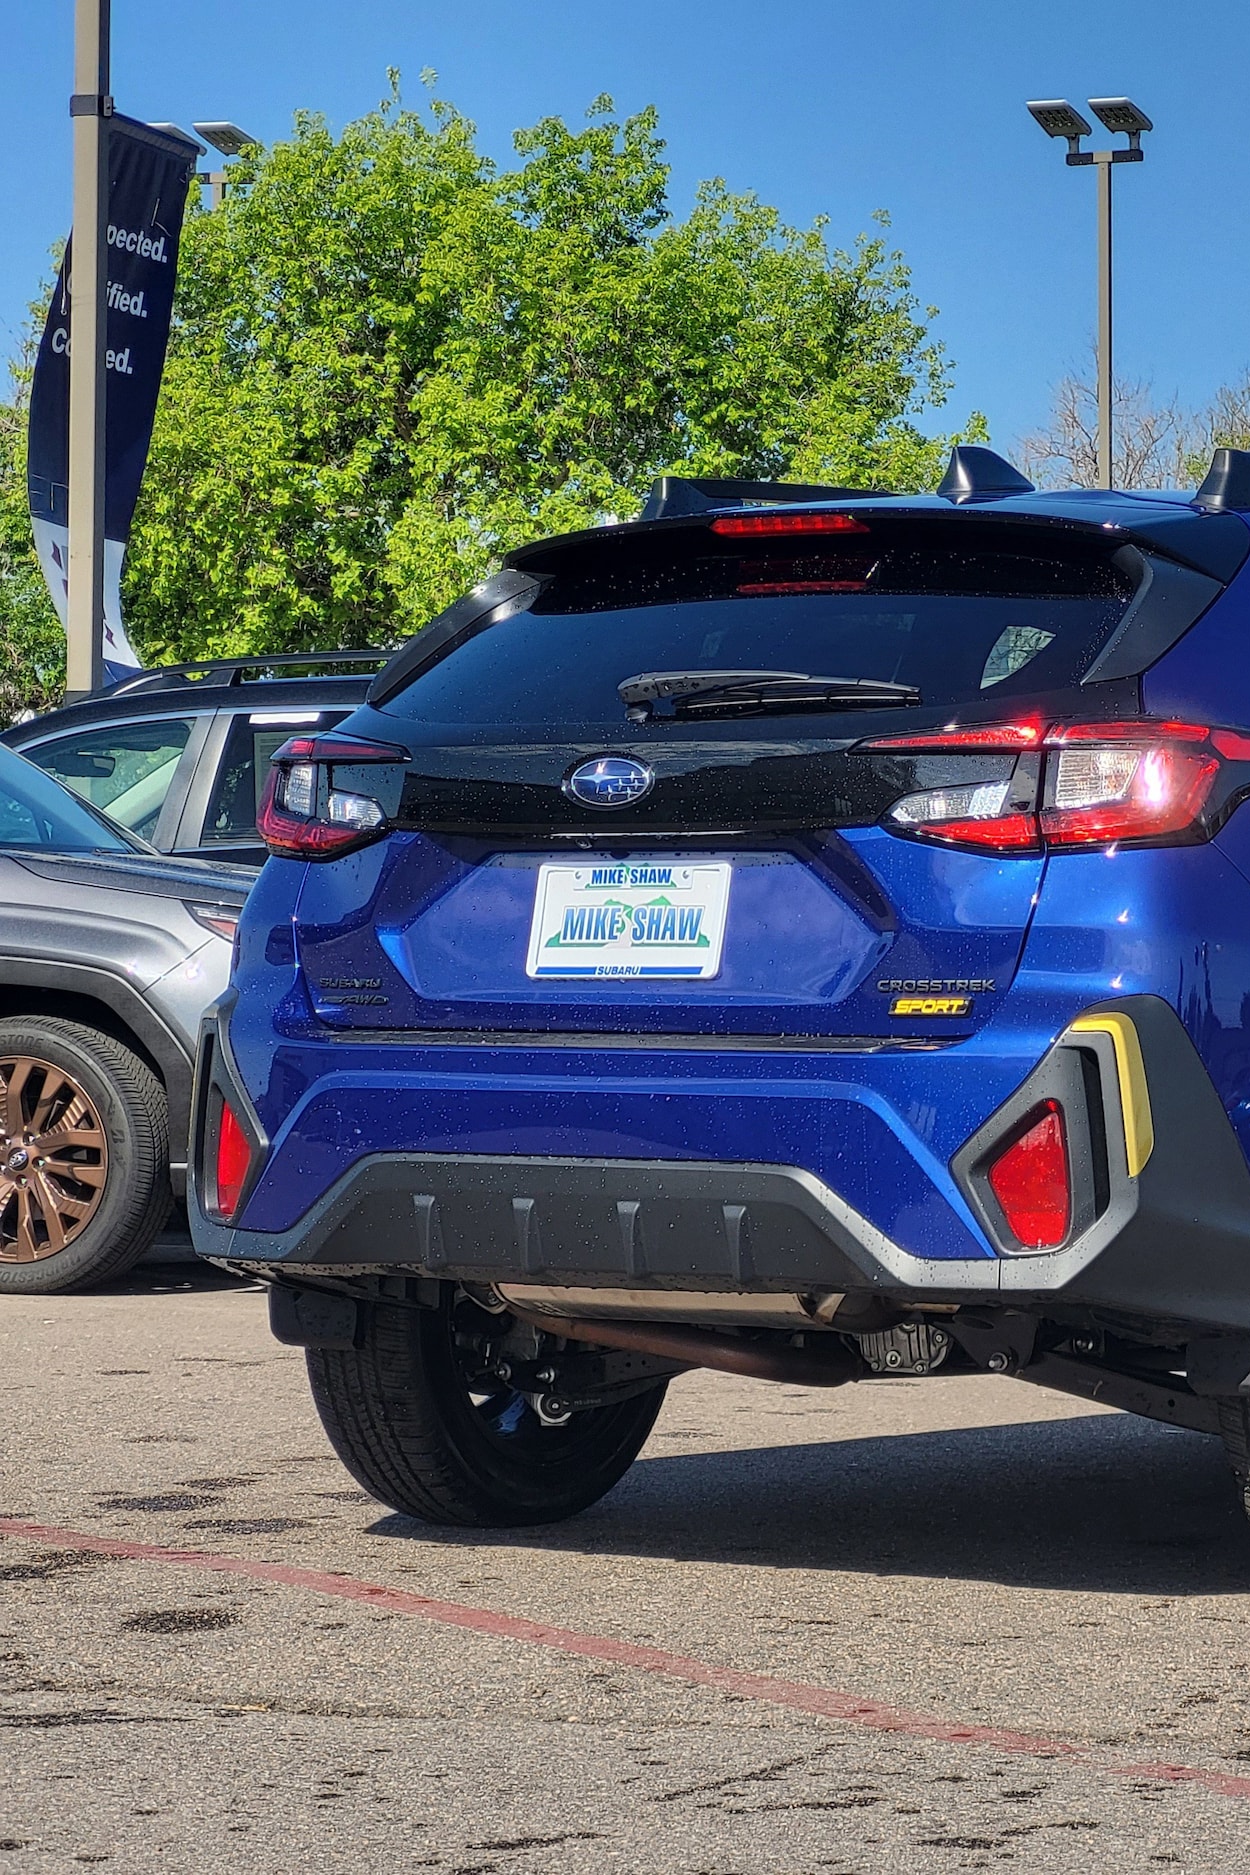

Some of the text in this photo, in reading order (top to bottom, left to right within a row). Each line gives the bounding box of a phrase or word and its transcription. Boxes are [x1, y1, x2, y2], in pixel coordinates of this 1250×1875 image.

[107, 224, 168, 263] pected.
[591, 868, 672, 885] MIKE SHAW
[562, 907, 703, 942] MIKE SHAW
[597, 966, 640, 976] SUBARU
[319, 977, 382, 989] SUBARU
[877, 979, 996, 993] CROSSTREK
[893, 998, 965, 1014] SPORT
